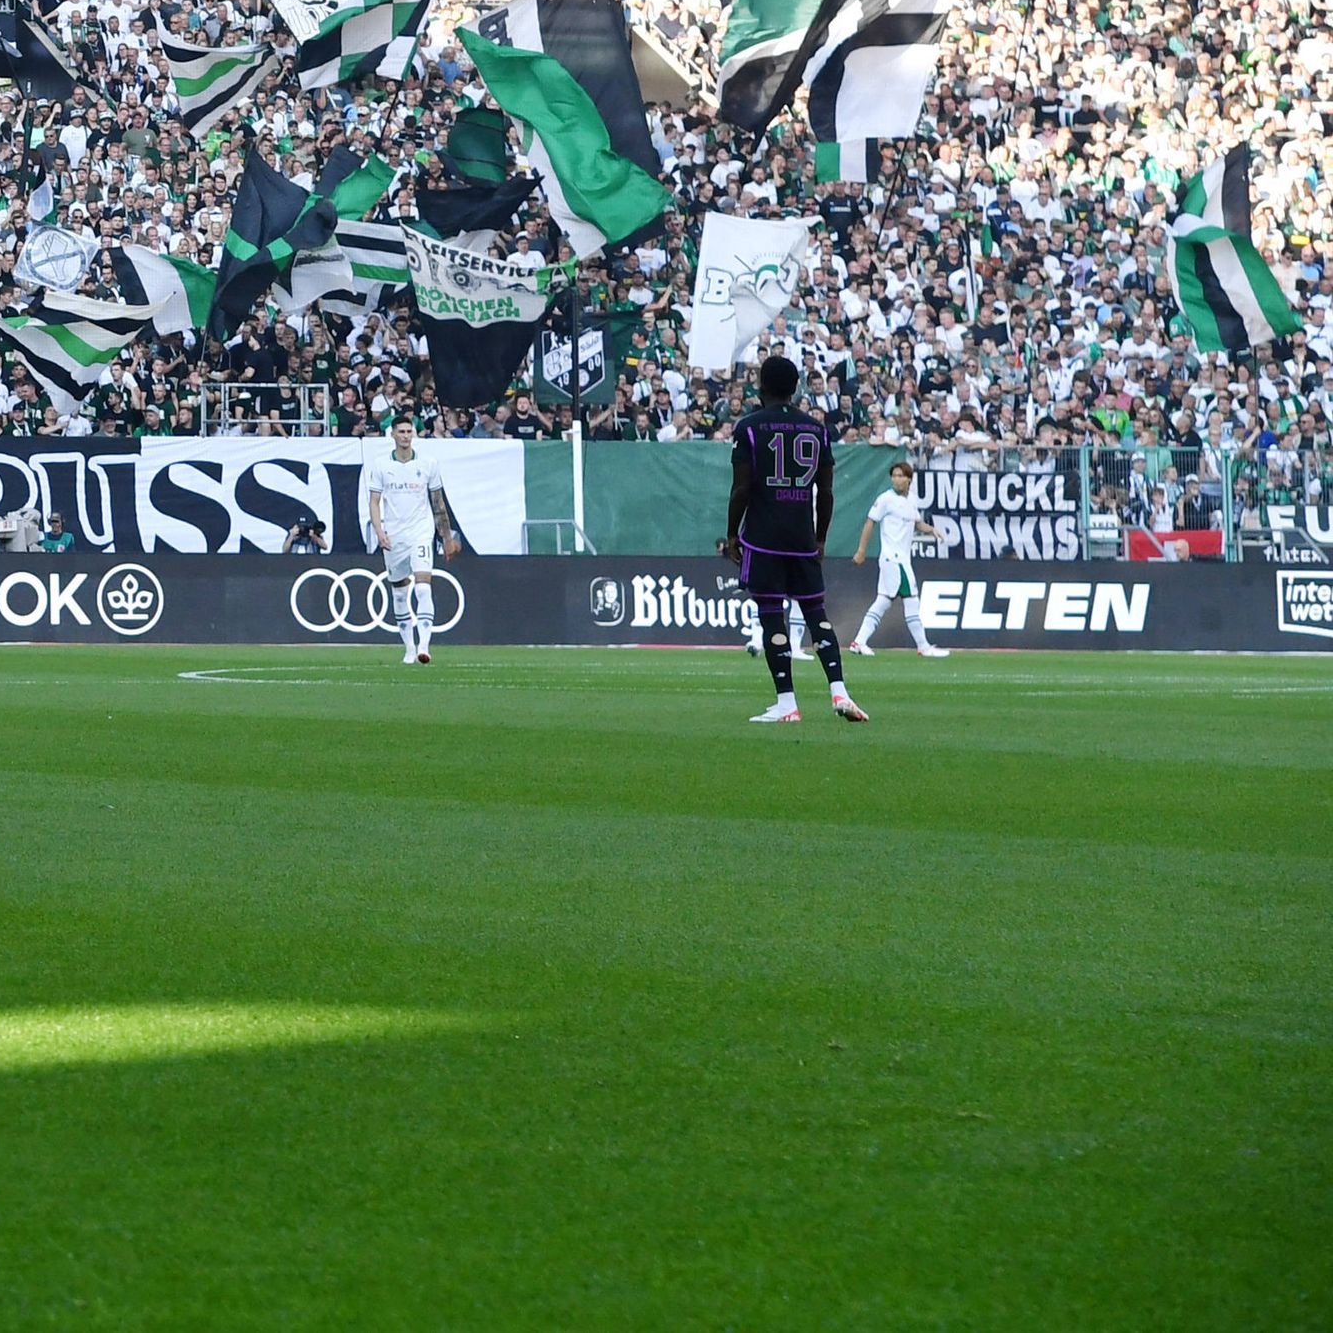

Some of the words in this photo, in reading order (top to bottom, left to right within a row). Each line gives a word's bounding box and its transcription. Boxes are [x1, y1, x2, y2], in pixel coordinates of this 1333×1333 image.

[417, 296, 520, 322] GLABACH
[766, 432, 821, 487] 19
[911, 471, 1077, 512] UMUCKL
[418, 544, 431, 557] 31
[933, 514, 1079, 561] PINKIS
[630, 573, 789, 640] Bitburg
[919, 580, 1151, 632] ELTEN
[1286, 578, 1333, 603] inte
[1290, 603, 1333, 622] wet
